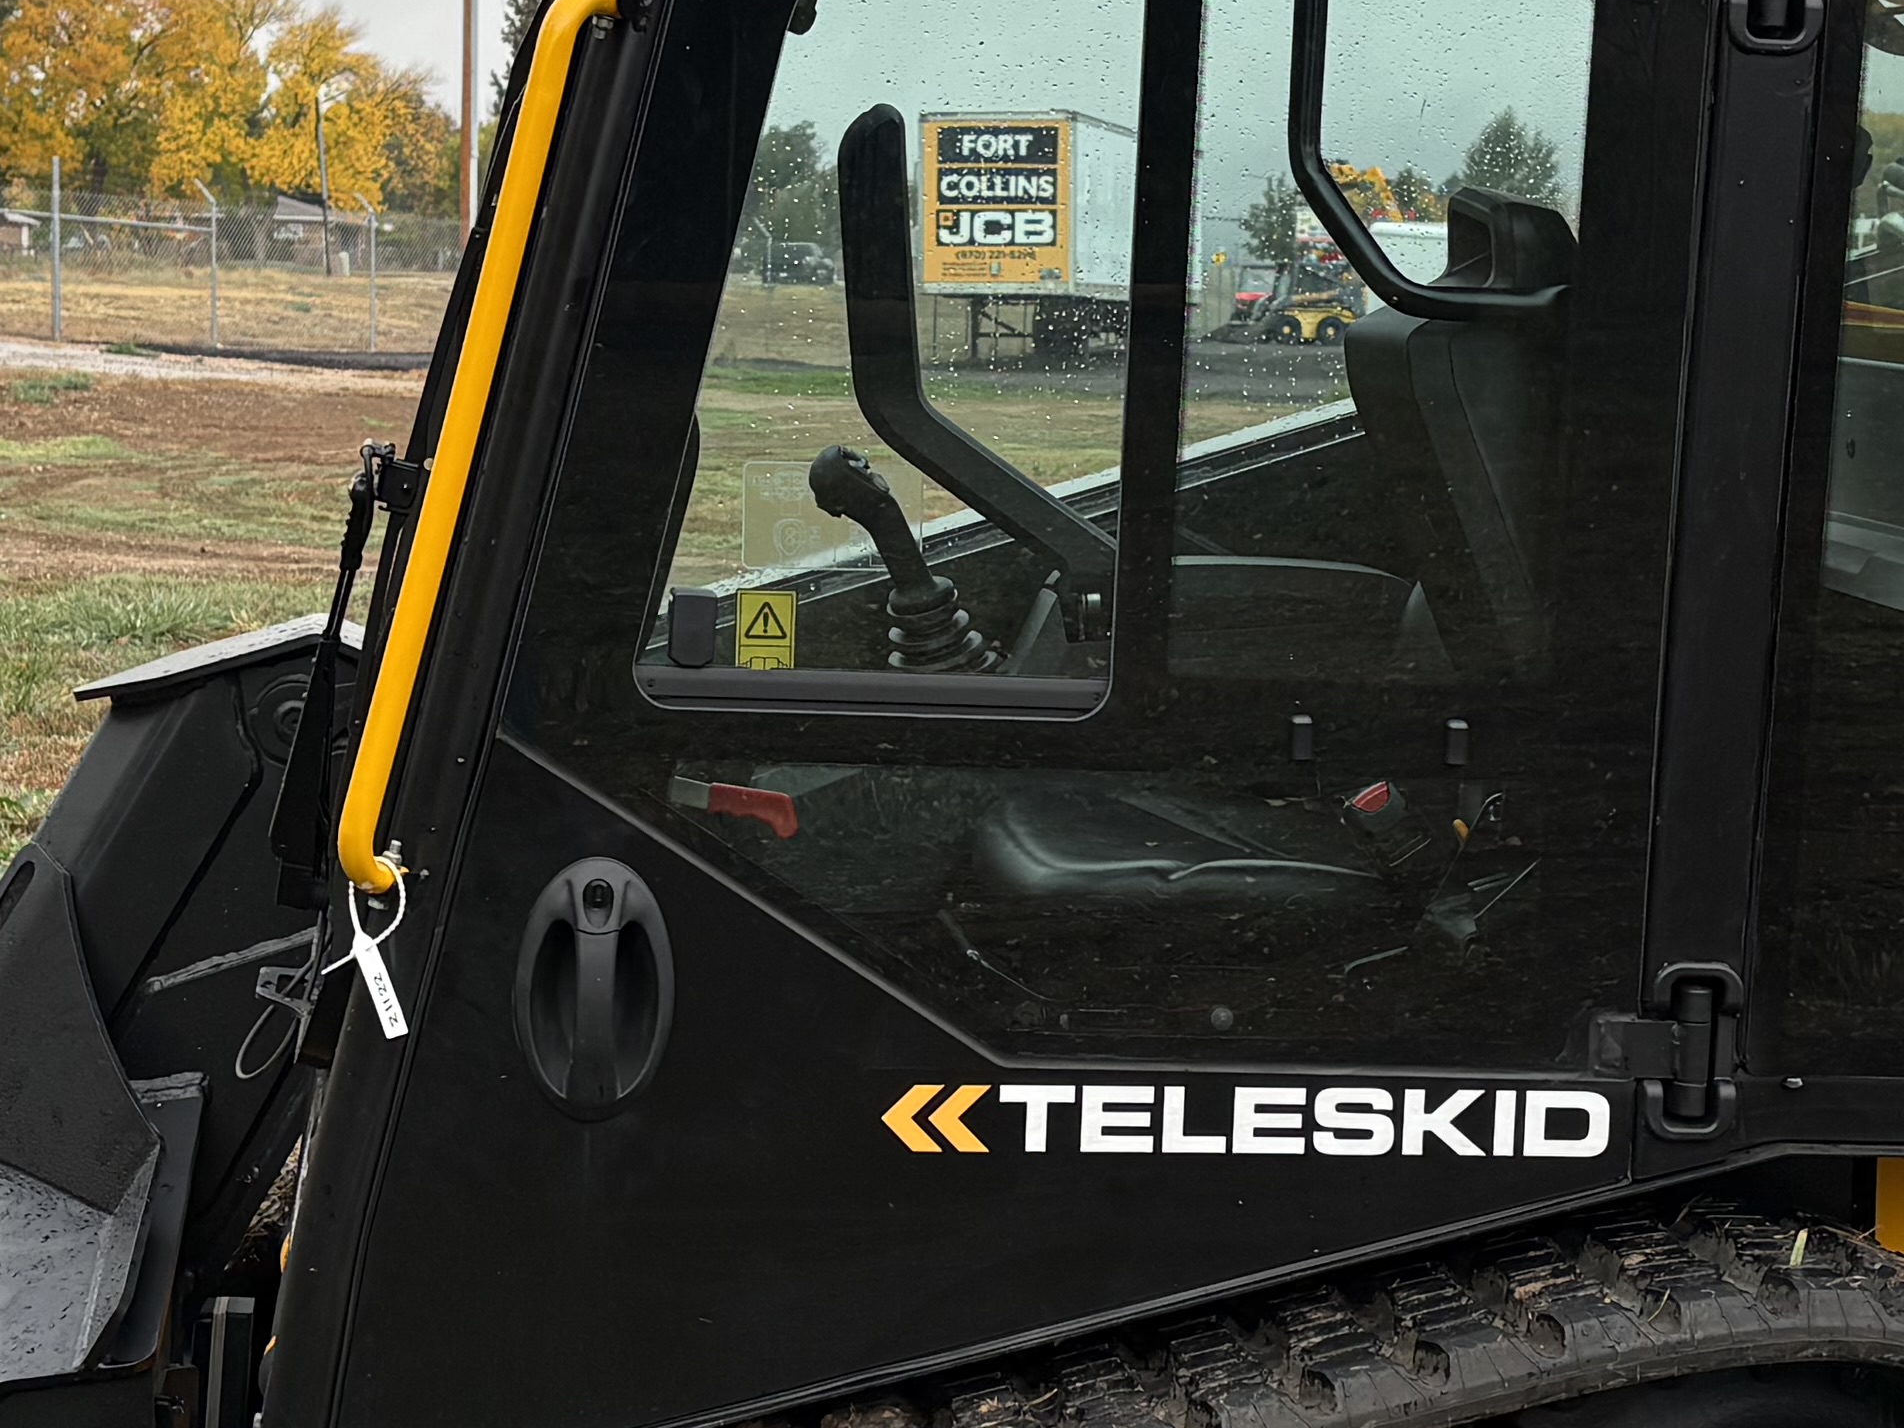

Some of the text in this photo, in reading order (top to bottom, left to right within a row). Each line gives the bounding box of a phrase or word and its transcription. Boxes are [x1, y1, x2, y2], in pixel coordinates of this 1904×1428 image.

[961, 133, 1034, 158] FORT
[939, 174, 1055, 198] COLLINS
[938, 211, 1055, 244] JCB
[1000, 1084, 1611, 1158] TELESKID
